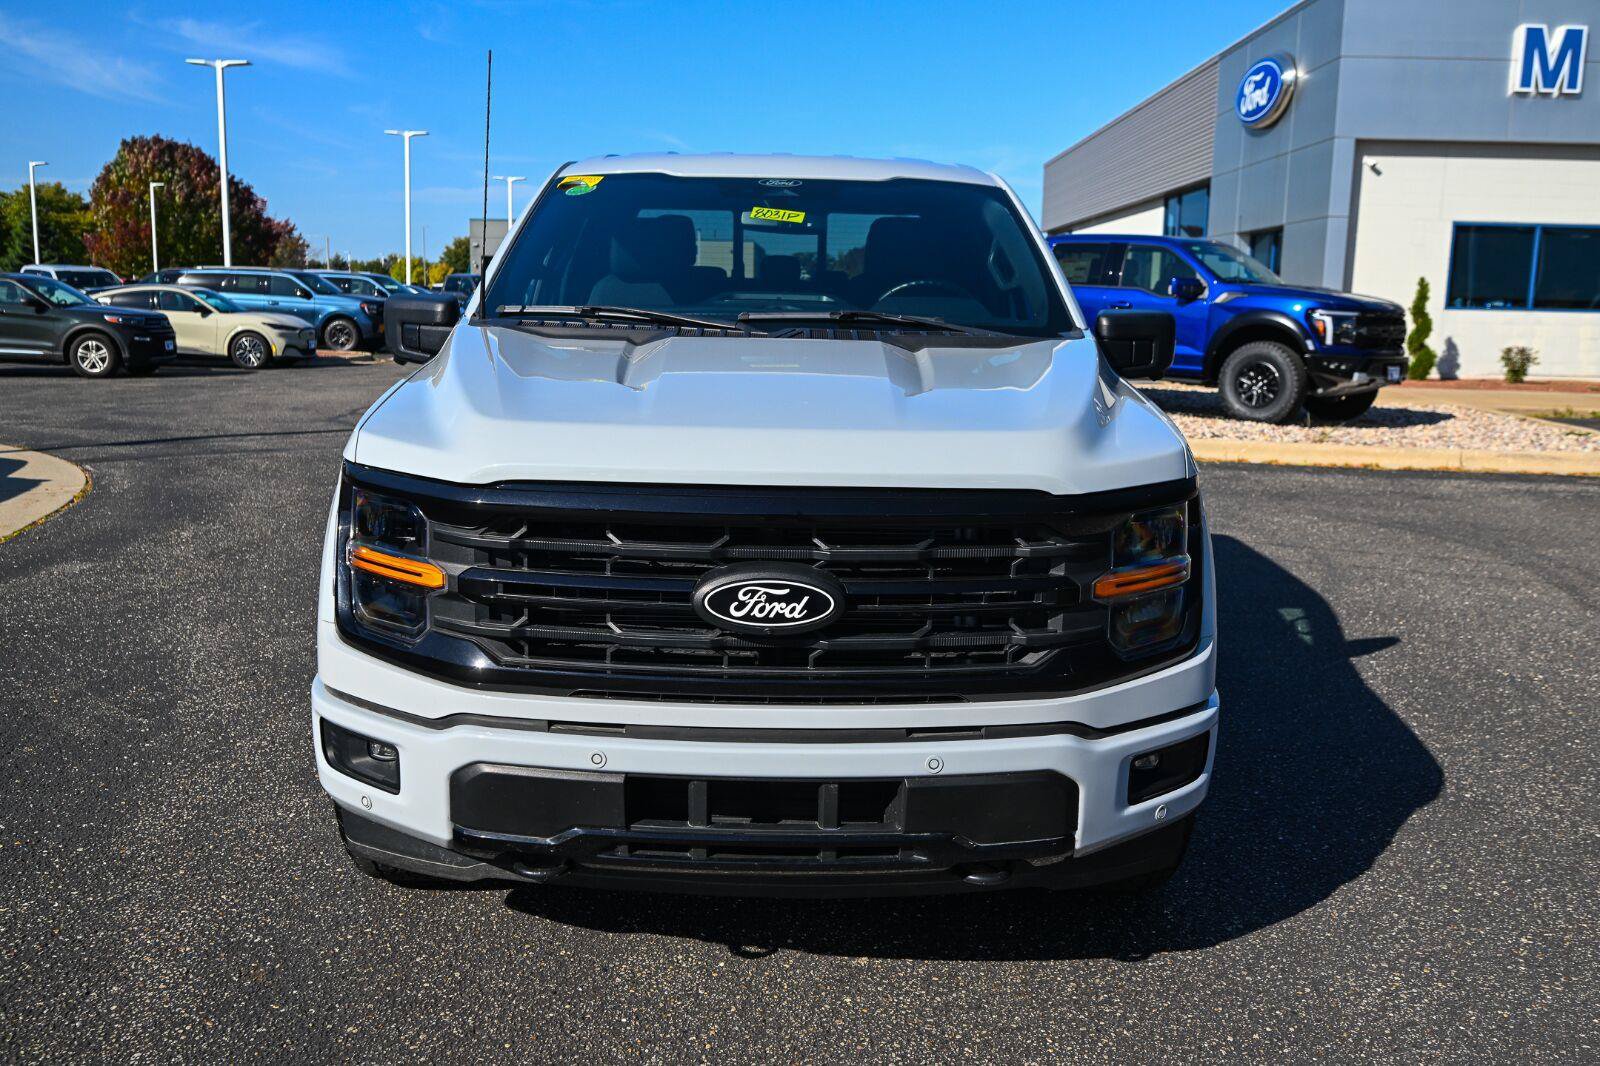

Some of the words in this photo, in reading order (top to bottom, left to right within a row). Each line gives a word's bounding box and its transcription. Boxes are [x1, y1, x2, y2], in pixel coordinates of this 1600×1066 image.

[1507, 23, 1588, 98] M
[1240, 71, 1272, 115] Ford
[729, 586, 810, 619] Ford
